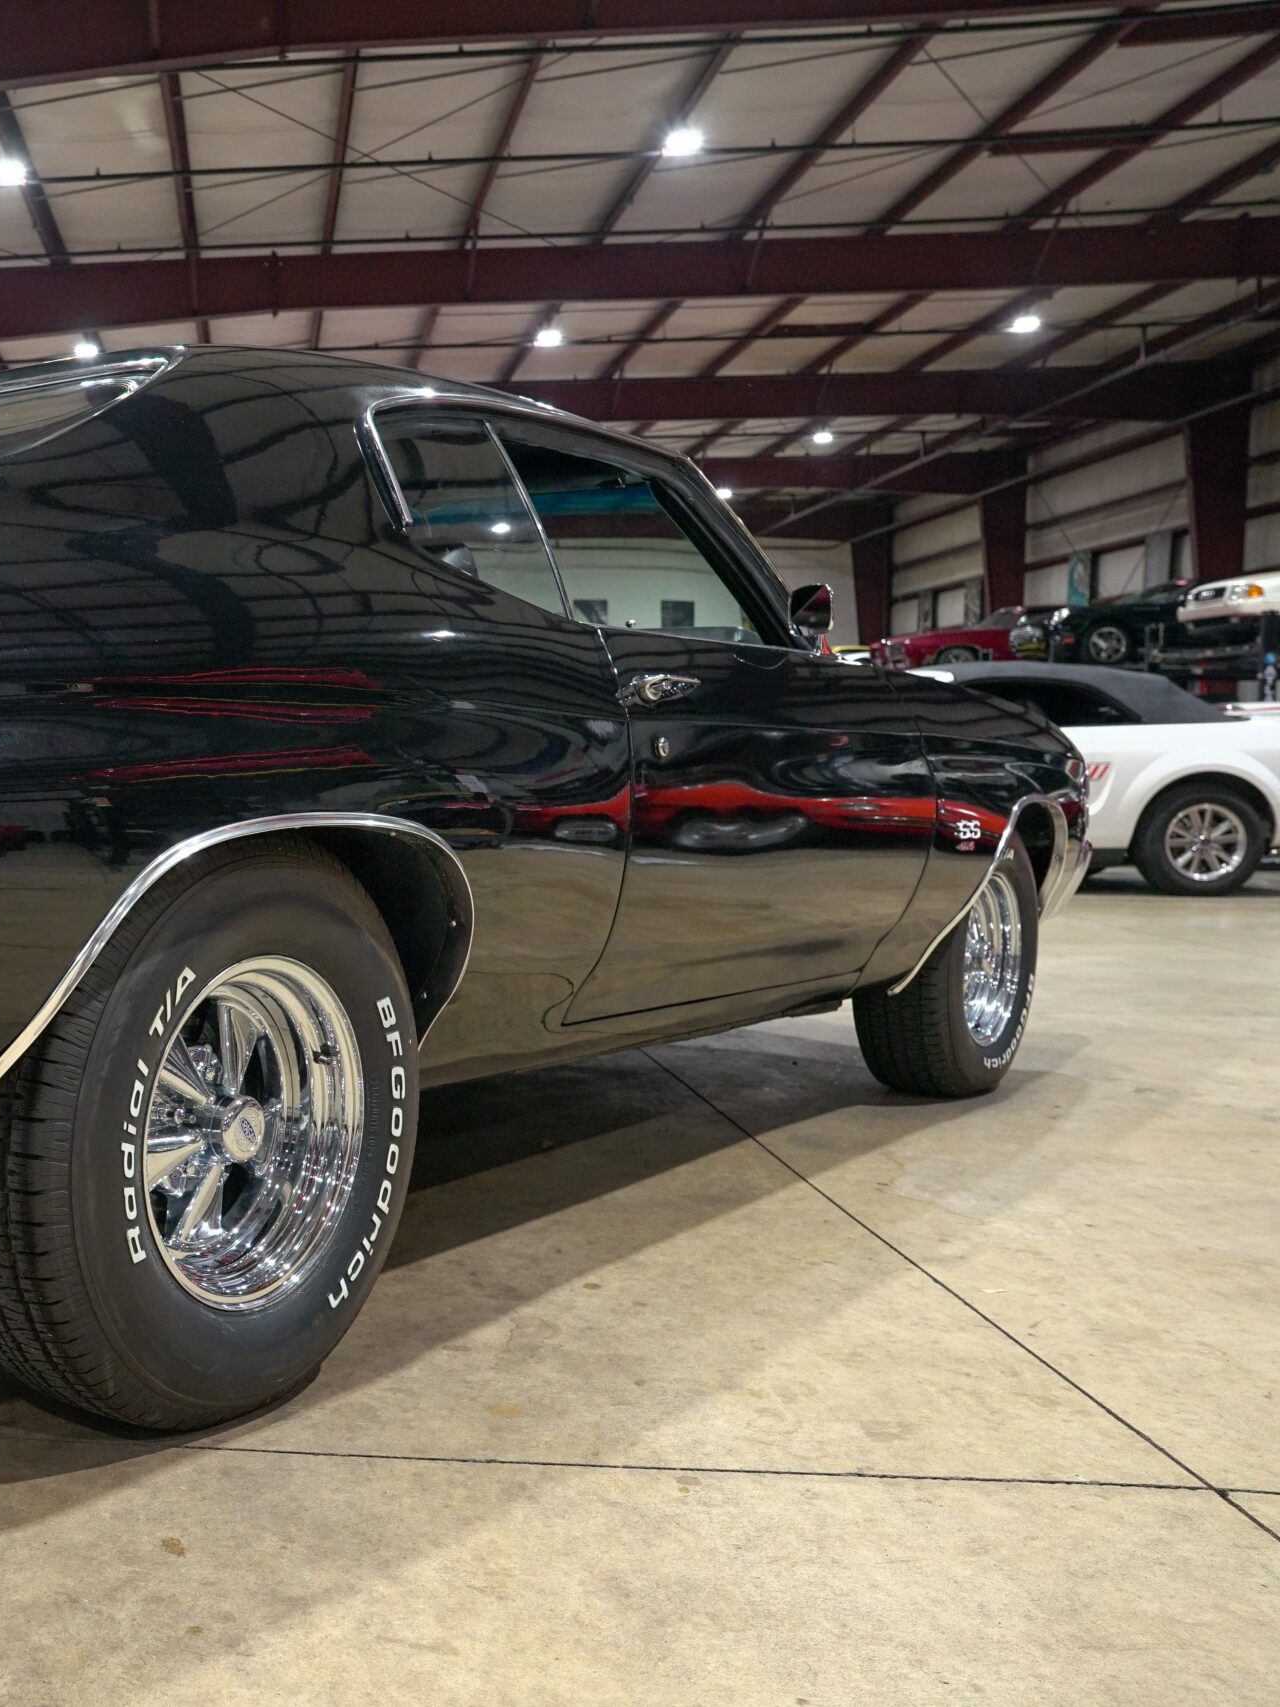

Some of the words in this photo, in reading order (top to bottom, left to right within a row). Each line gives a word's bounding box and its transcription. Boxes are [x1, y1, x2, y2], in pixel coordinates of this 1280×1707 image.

[956, 819, 981, 840] SS
[121, 1057, 149, 1265] Radial
[148, 966, 197, 1039] T/A
[326, 996, 407, 1310] BFGoodrich
